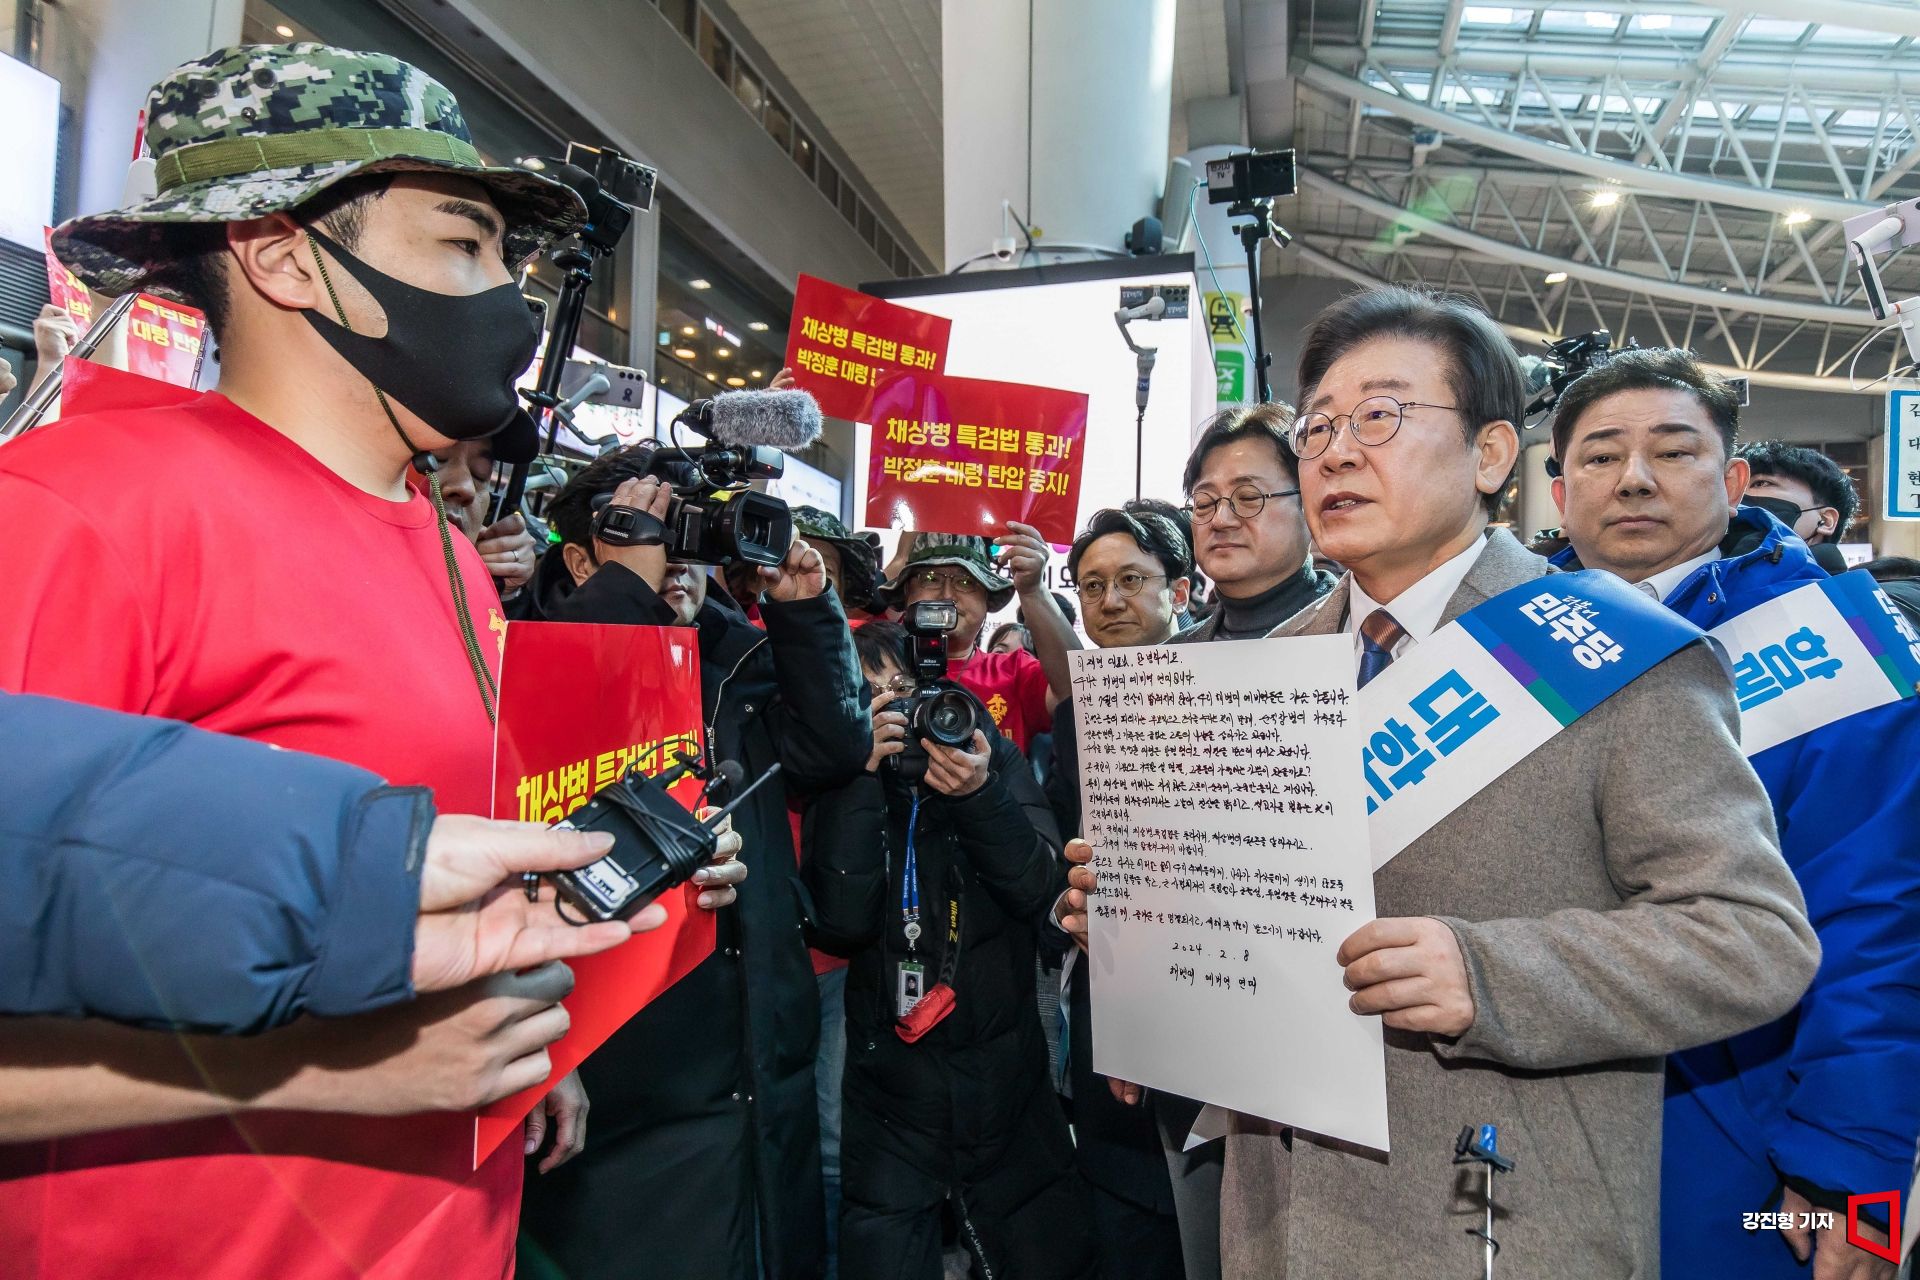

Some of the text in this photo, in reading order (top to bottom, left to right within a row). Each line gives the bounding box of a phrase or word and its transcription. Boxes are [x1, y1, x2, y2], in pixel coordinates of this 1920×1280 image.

[131, 319, 170, 347] 대령
[801, 316, 937, 370] 채상병 특검법 통과!
[797, 348, 839, 377] 박정훈
[841, 360, 869, 386] 대령
[886, 417, 1072, 459] 채상병 특검법 통과!
[883, 456, 1070, 496] 박정훈 대령 탄압 중지!
[1562, 595, 1600, 619] 더불어
[1519, 592, 1625, 670] 민주당
[516, 758, 590, 824] 채상병
[949, 900, 958, 943] Nikon Z
